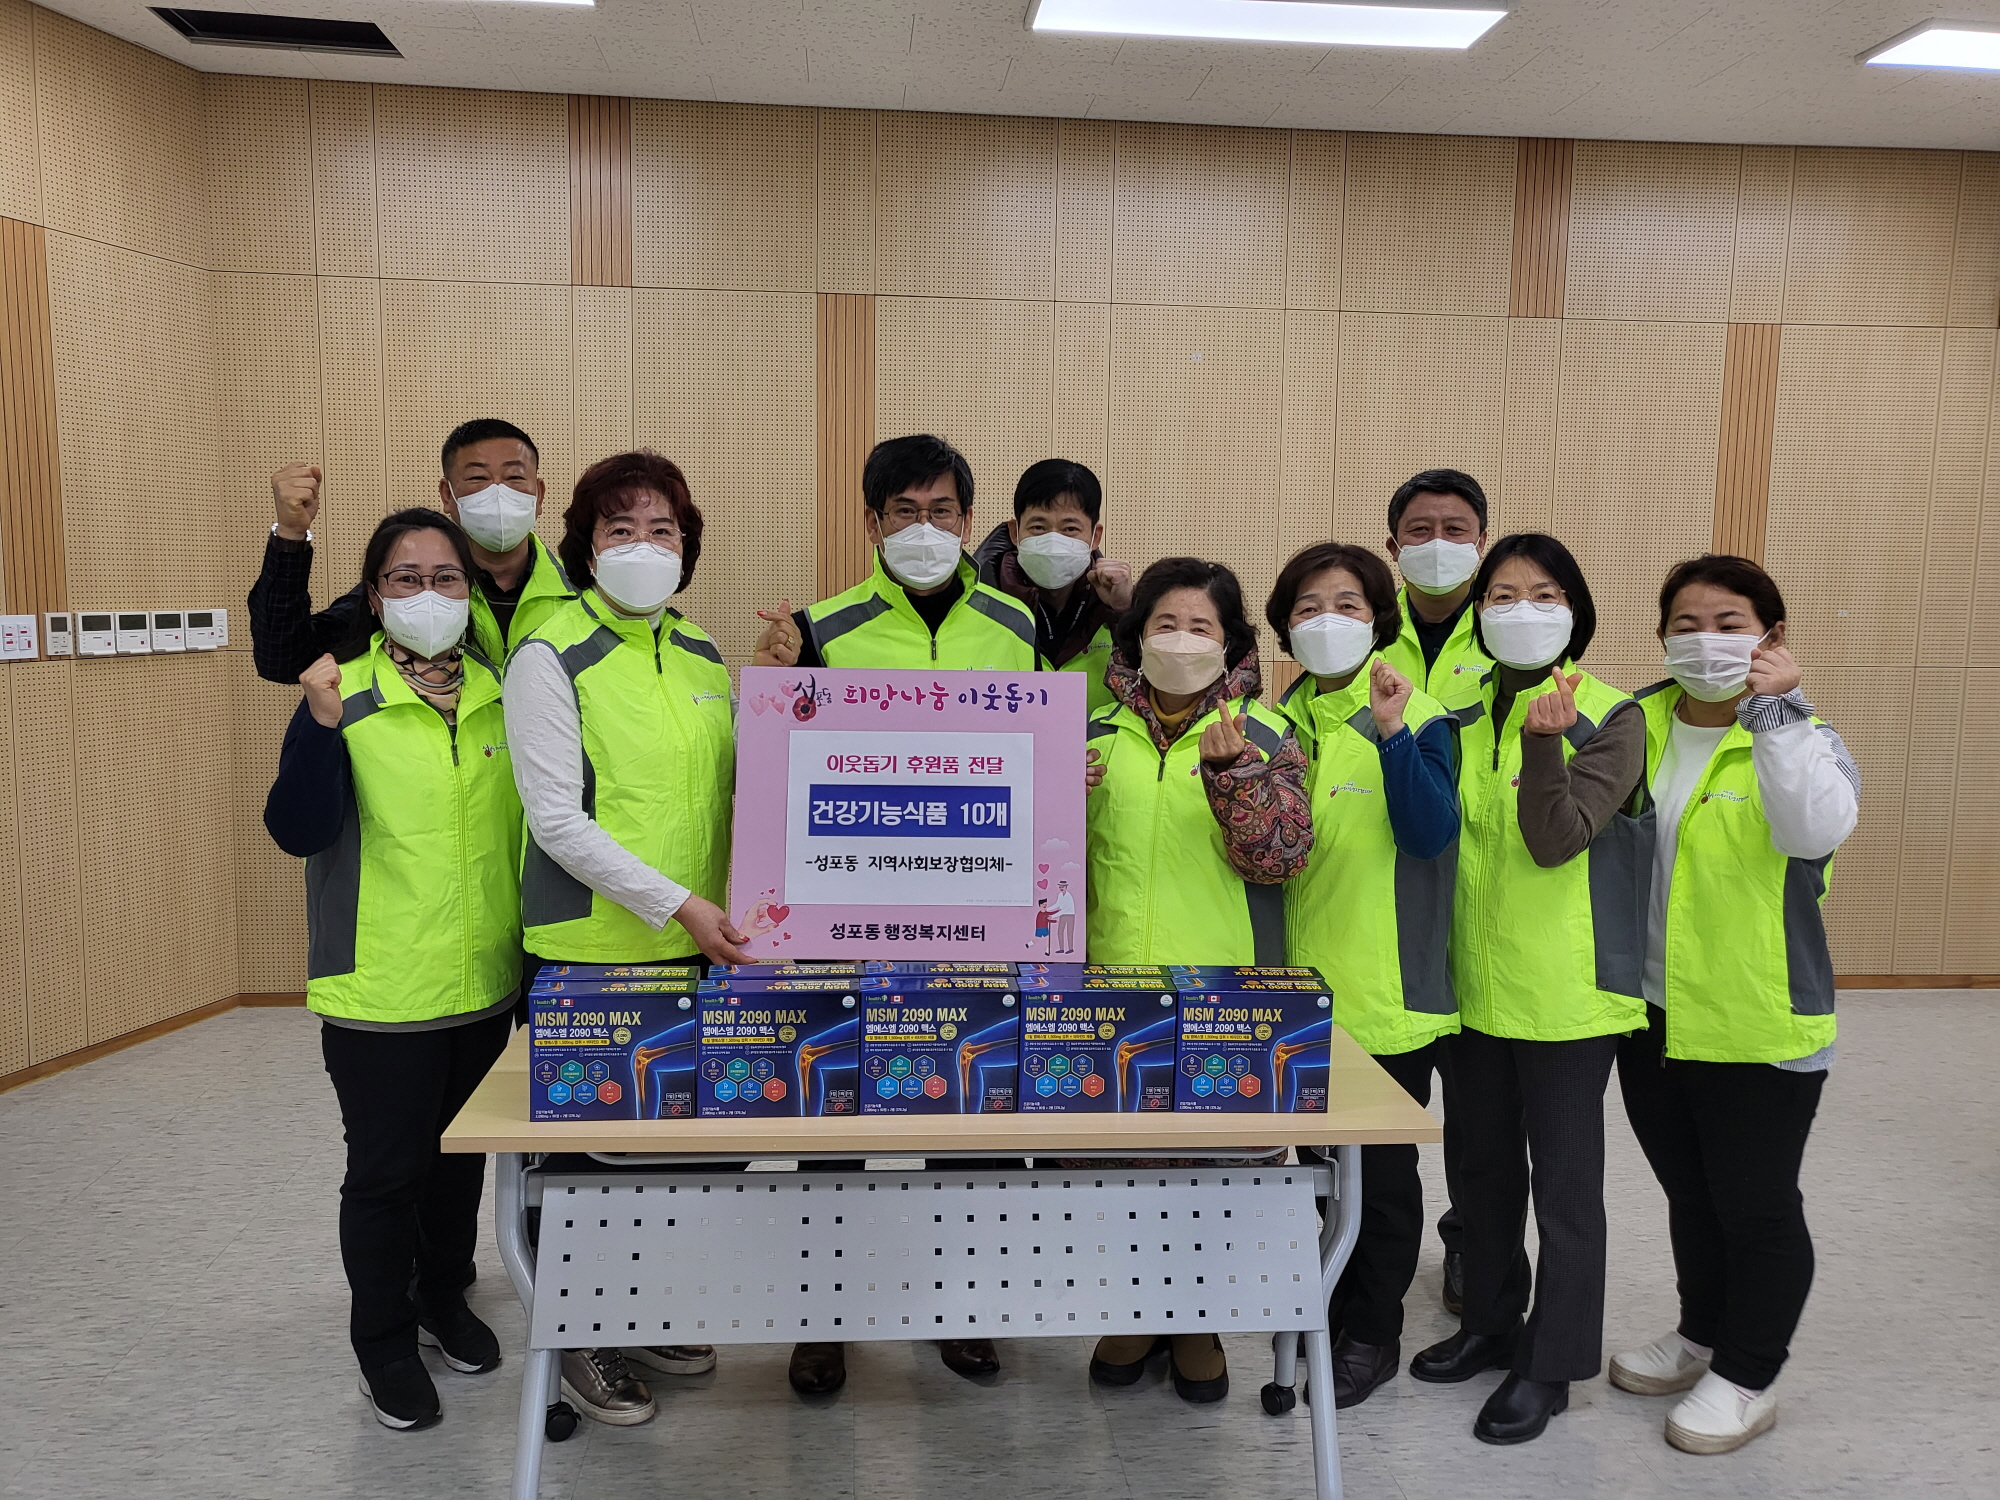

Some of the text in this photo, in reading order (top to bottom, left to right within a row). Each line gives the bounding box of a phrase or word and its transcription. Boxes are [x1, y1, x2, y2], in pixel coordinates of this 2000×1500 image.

[843, 681, 1048, 713] 희망나눔 이웃돕기
[826, 755, 1004, 774] 이웃돕기 후원품 전달
[812, 800, 1007, 827] 건강기능식품 10개
[805, 855, 1013, 873] -성포동 지역사회보장협의체-
[829, 923, 986, 941] 성포동 행정복지센터
[535, 1012, 641, 1026] MSM 2090 MAX
[703, 1010, 806, 1024] MSM 2090 MAX
[866, 1008, 967, 1022] MSM 2090 MAX
[1026, 1008, 1125, 1021] MSM 2090 MAX
[1183, 1008, 1282, 1022] MSM 2090 MAX
[535, 1028, 567, 1038] 엠에스엠
[570, 1029, 590, 1037] 2090
[593, 1029, 609, 1037] 맥스
[703, 1027, 733, 1035] 엠에스엠
[736, 1027, 756, 1035] 2090
[759, 1027, 775, 1035] 맥스
[866, 1025, 896, 1033] 엠에스엠
[899, 1024, 918, 1032] 2090
[921, 1024, 936, 1033] 맥스
[1026, 1023, 1055, 1032] 엠에스엠
[1058, 1023, 1077, 1031] 2090
[1080, 1023, 1095, 1032] 맥스
[1183, 1024, 1212, 1032] 엠에스엠
[1215, 1024, 1234, 1032] 2090
[1237, 1024, 1251, 1032] 맥스
